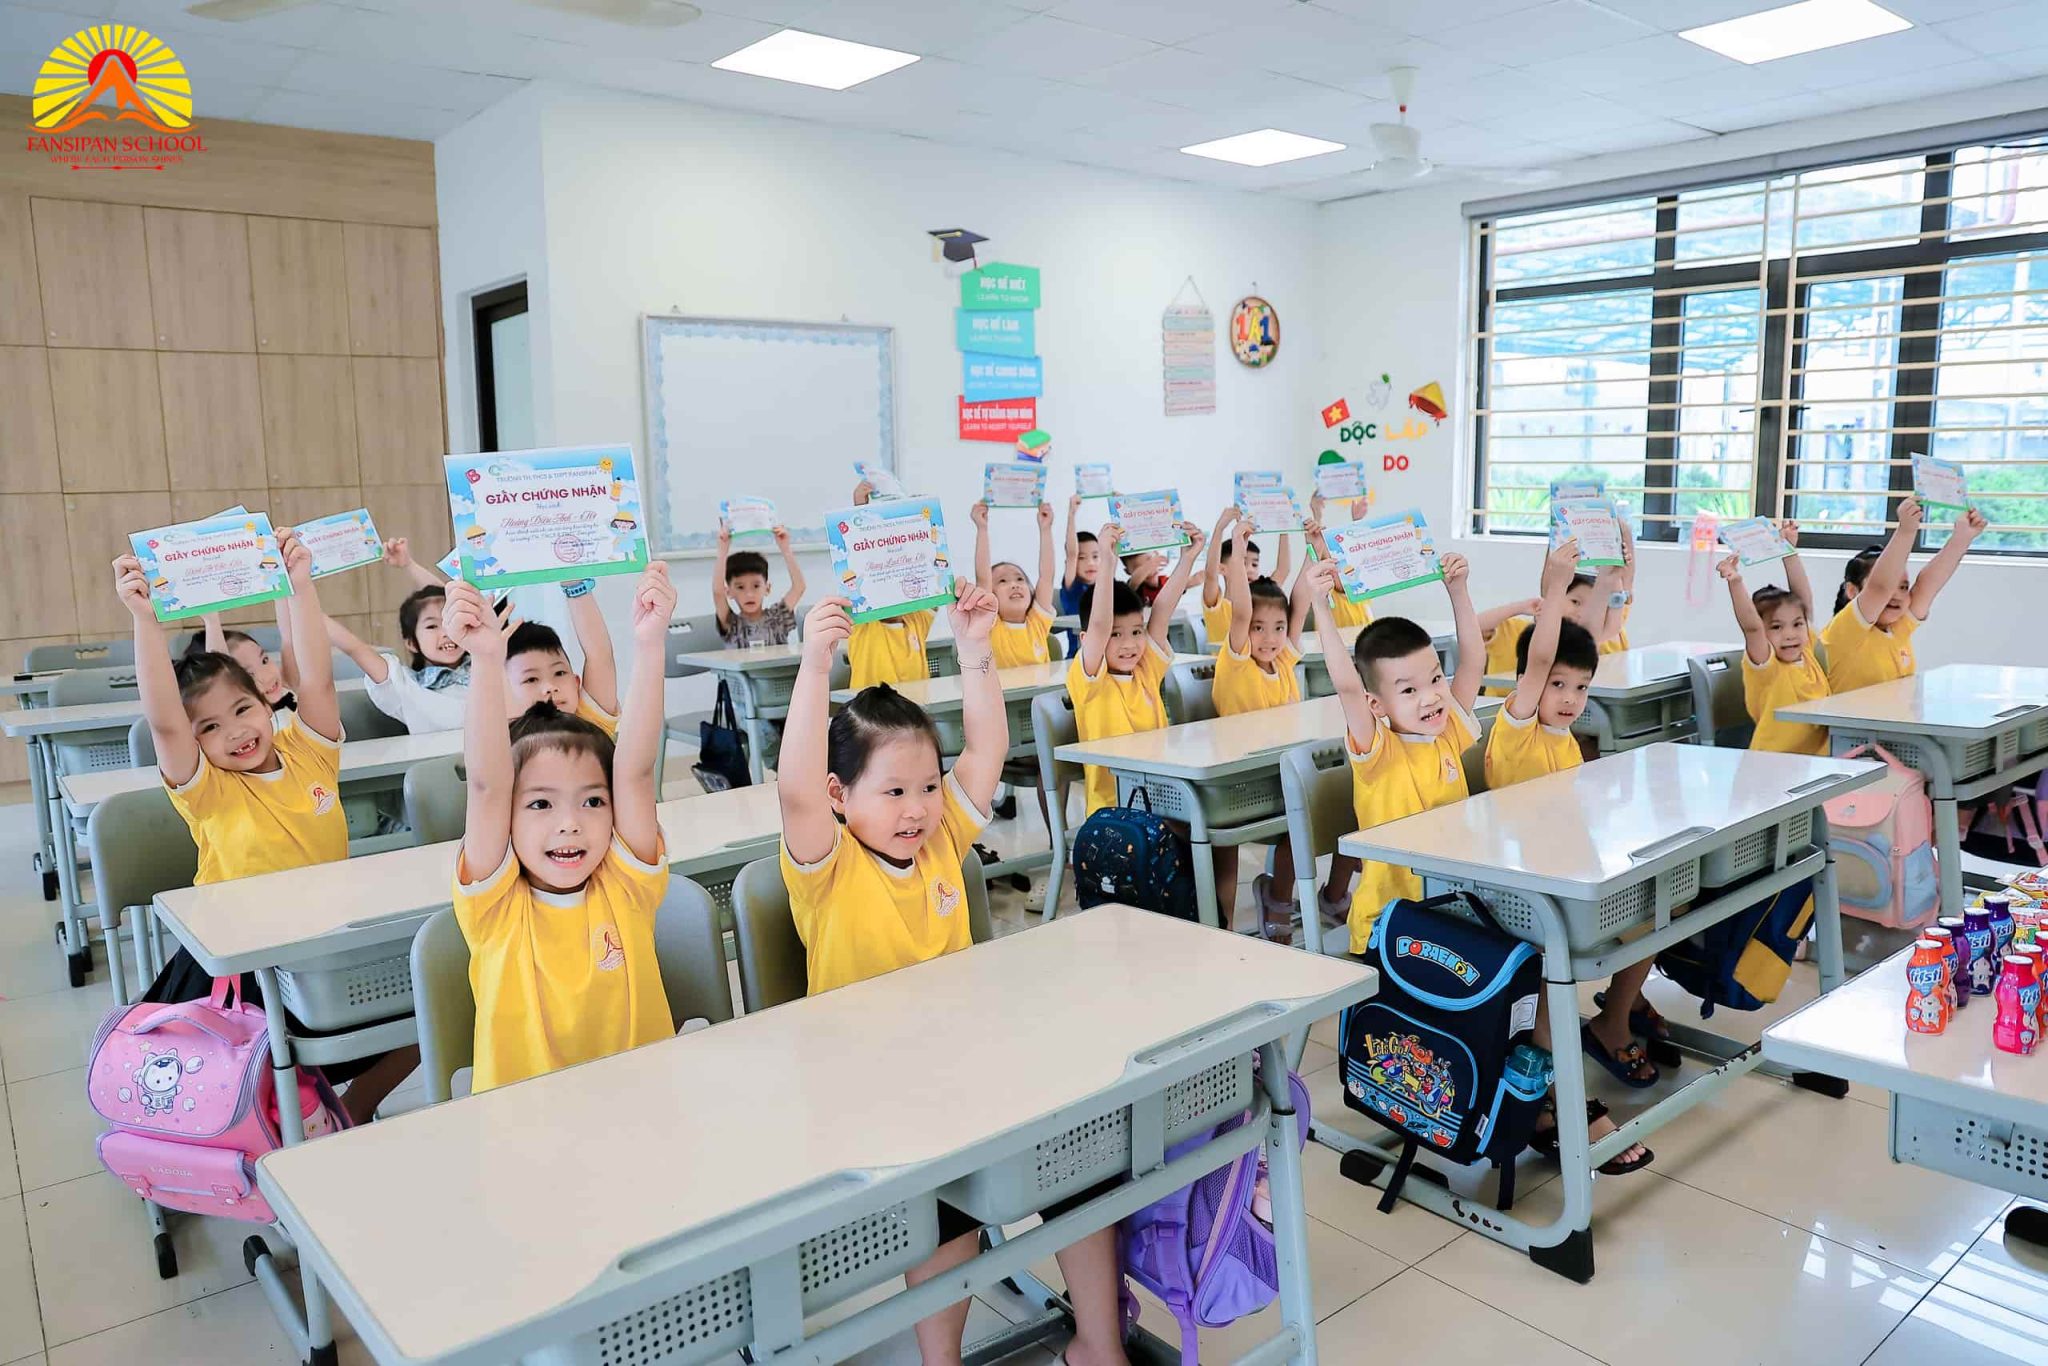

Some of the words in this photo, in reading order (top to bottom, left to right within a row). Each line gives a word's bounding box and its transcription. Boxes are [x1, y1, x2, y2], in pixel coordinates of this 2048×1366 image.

[1383, 455, 1409, 471] DO
[522, 488, 569, 502] CHỨNG
[572, 484, 607, 498] NHẬN
[877, 534, 907, 547] CHỨNG
[907, 530, 929, 542] NHẬN
[191, 545, 226, 557] CHỨNG
[228, 540, 254, 551] NHẬN
[1396, 935, 1480, 987] DORAEMON
